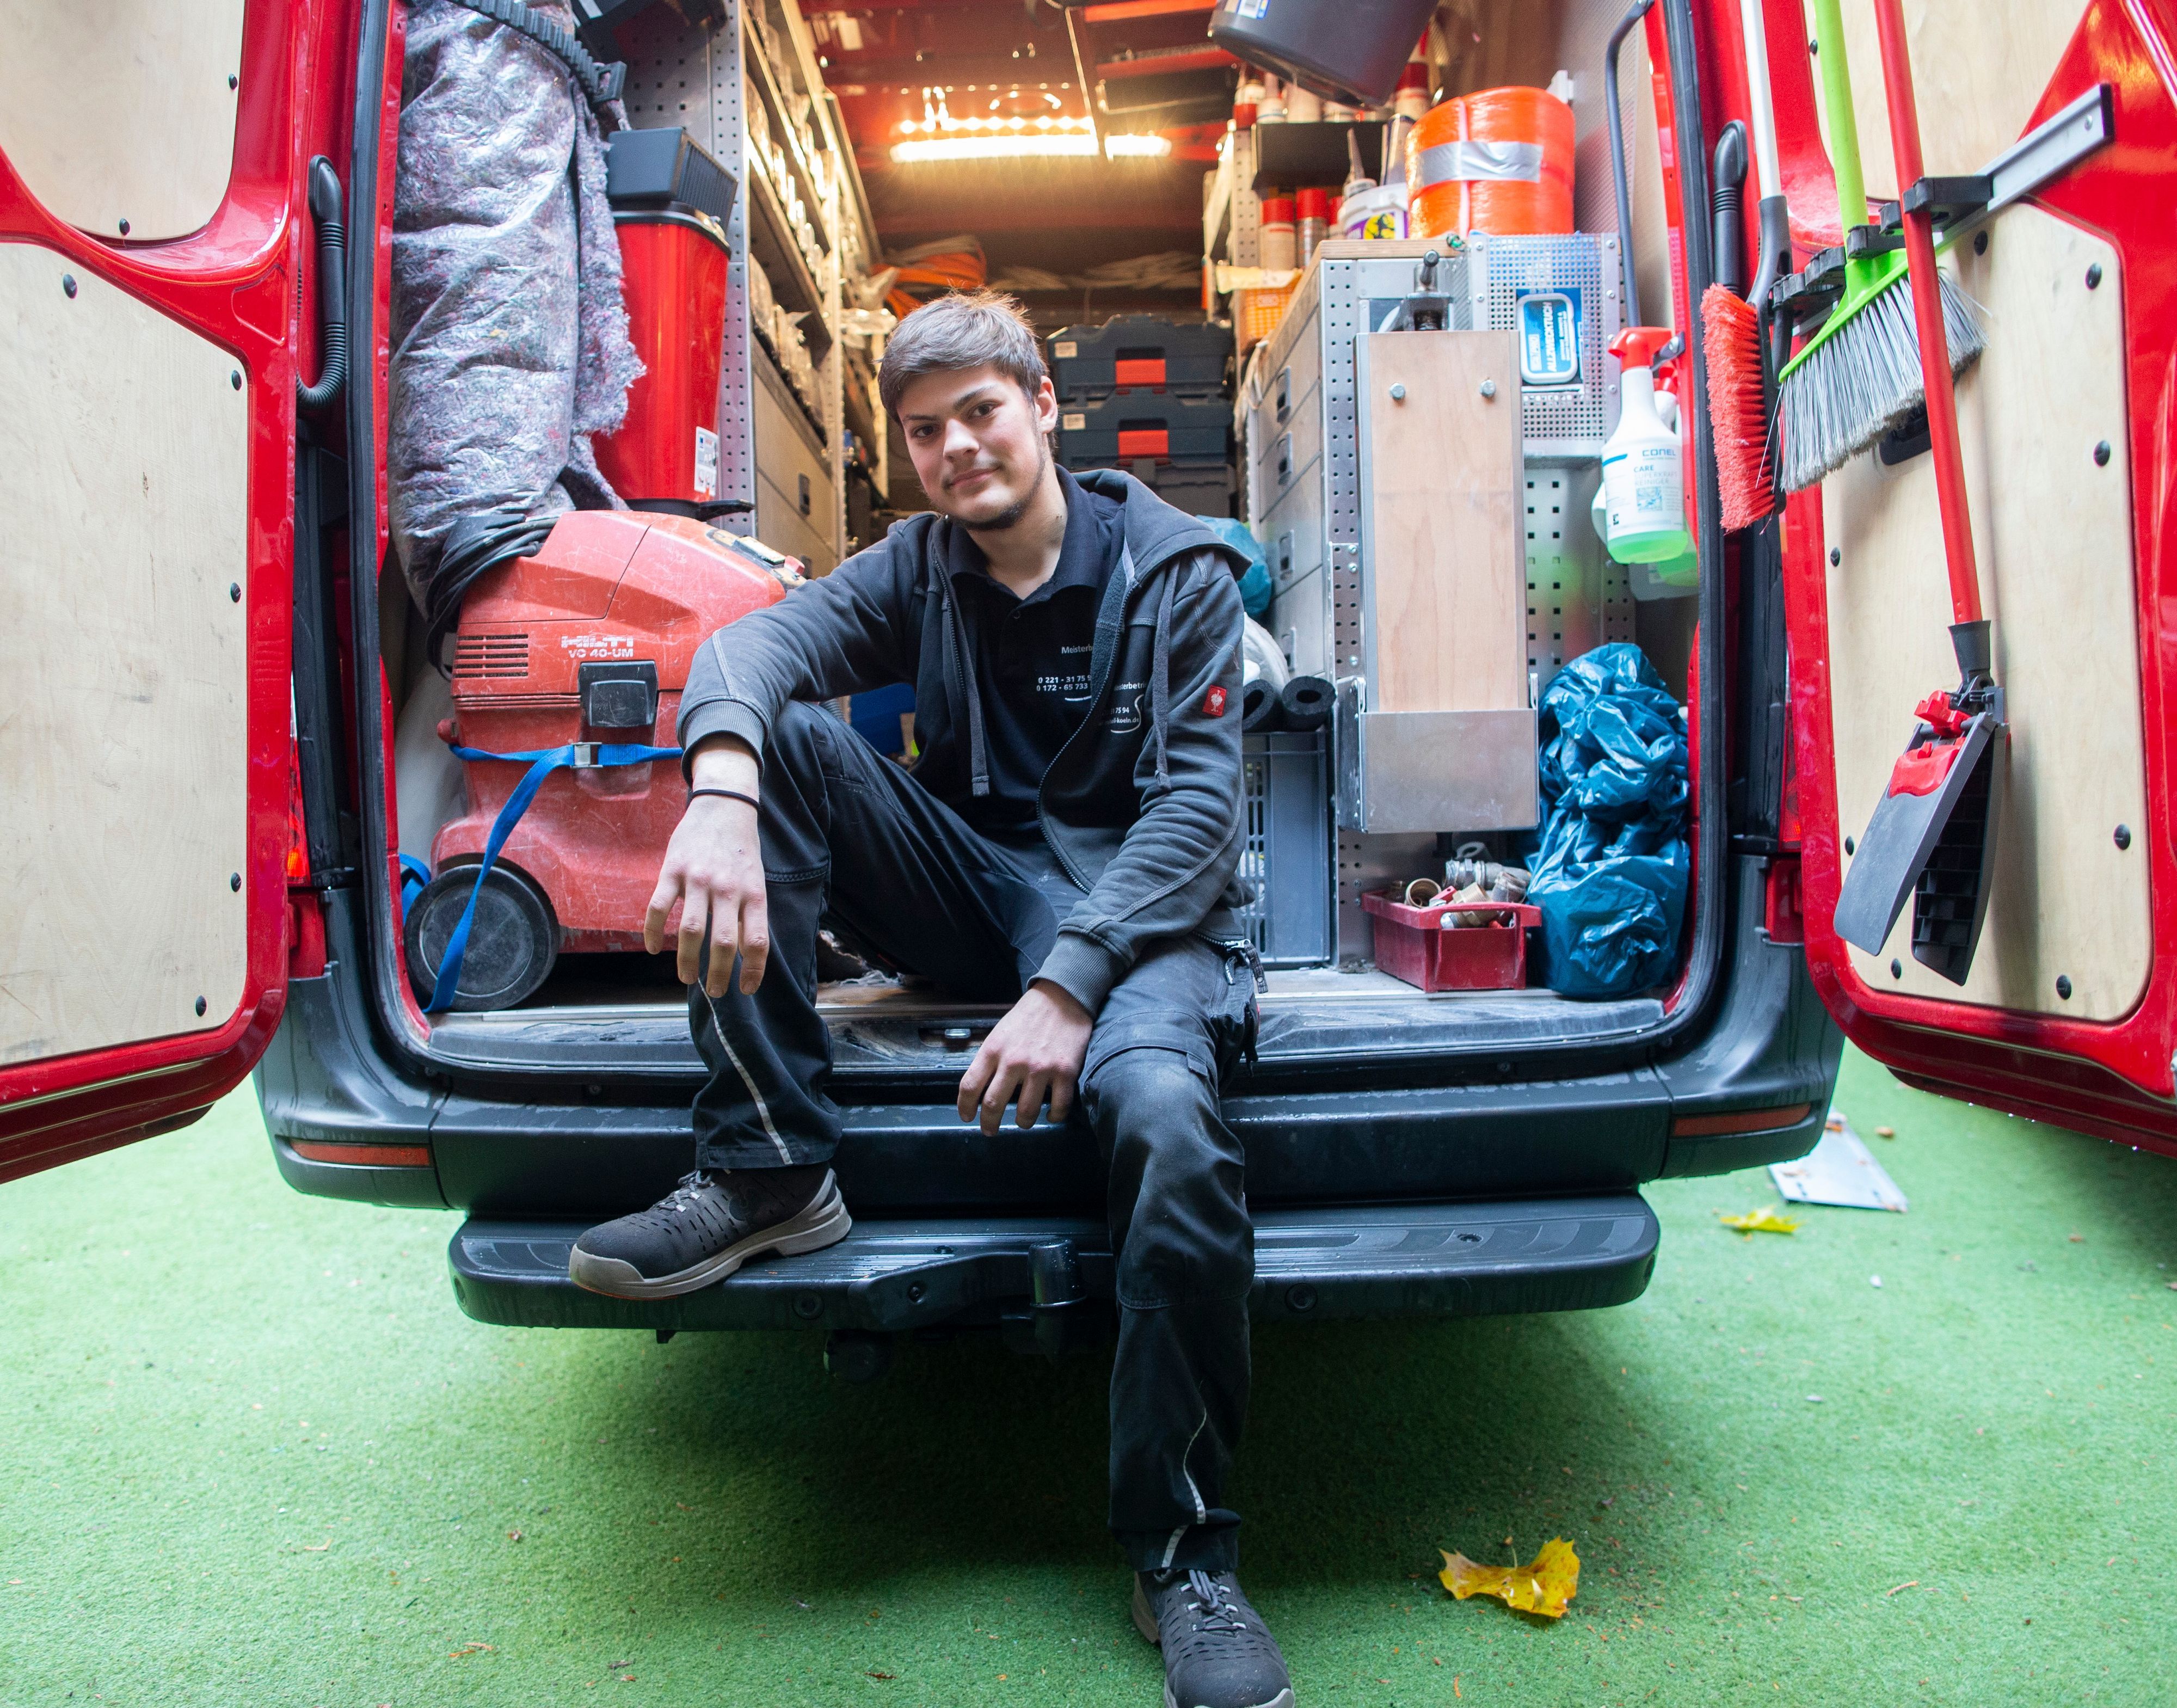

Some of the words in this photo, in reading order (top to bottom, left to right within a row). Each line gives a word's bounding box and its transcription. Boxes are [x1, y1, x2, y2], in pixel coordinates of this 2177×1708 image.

[1542, 302, 1557, 372] ALLZWECKTUCH
[561, 635, 634, 648] HILTI
[589, 648, 634, 658] 40-UM
